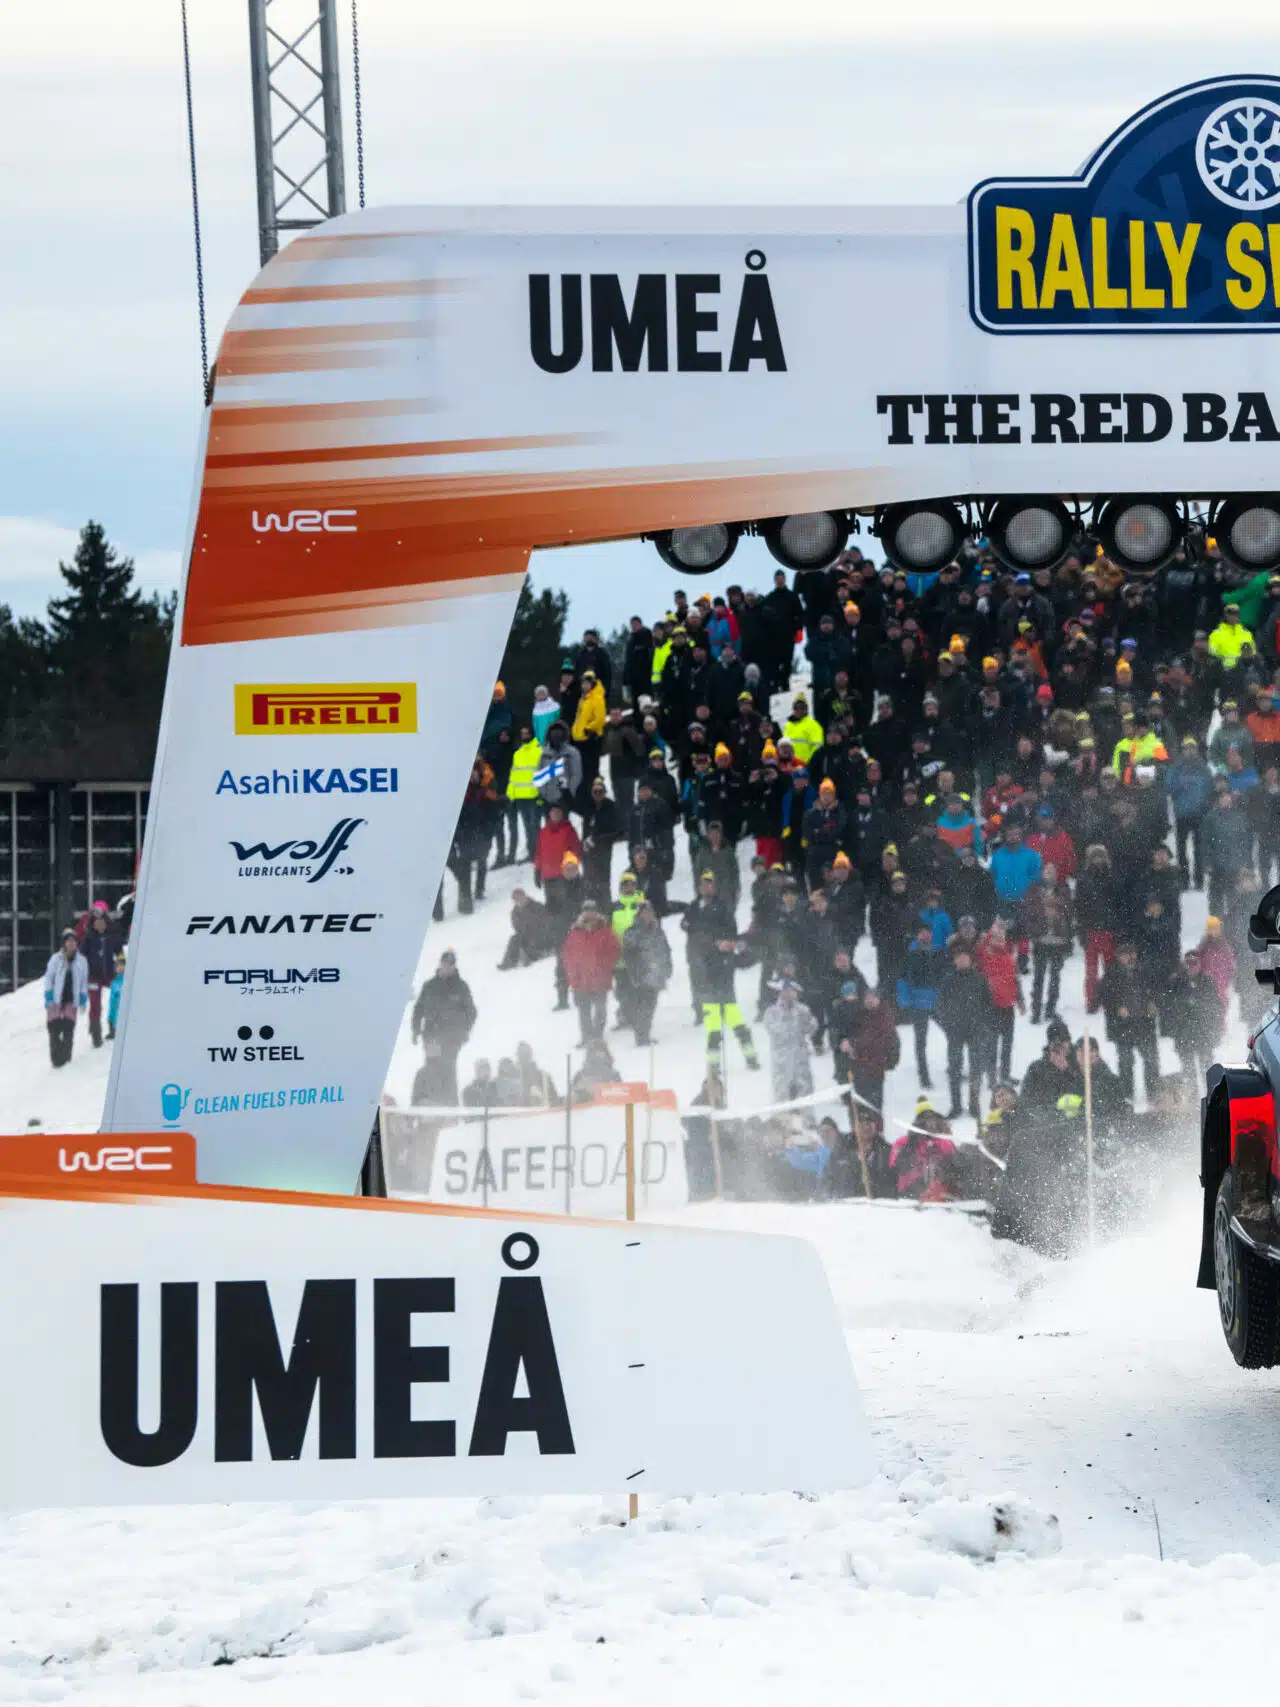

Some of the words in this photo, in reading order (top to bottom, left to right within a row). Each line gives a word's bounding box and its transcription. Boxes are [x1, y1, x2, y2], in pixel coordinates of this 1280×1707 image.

[995, 205, 1202, 310] RALLY
[528, 249, 788, 374] UMEÅ
[876, 394, 1022, 445] THE
[1030, 393, 1174, 444] RED
[252, 509, 358, 533] WRC
[251, 692, 402, 726] PIRELLI
[215, 767, 399, 795] AsahiKASEI
[238, 865, 312, 877] LUBRICANTS
[186, 913, 377, 935] FANATEC
[203, 967, 341, 985] FORUM8
[240, 985, 305, 995] フォーラムエイト
[207, 1047, 238, 1062] TW
[243, 1046, 305, 1062] STEEL
[194, 1094, 240, 1115] CLEAN
[243, 1090, 287, 1110] FUELS
[289, 1087, 318, 1106] FOR
[319, 1085, 345, 1103] ALL
[58, 1146, 173, 1172] WRC
[99, 1231, 577, 1468] UMEÅ
